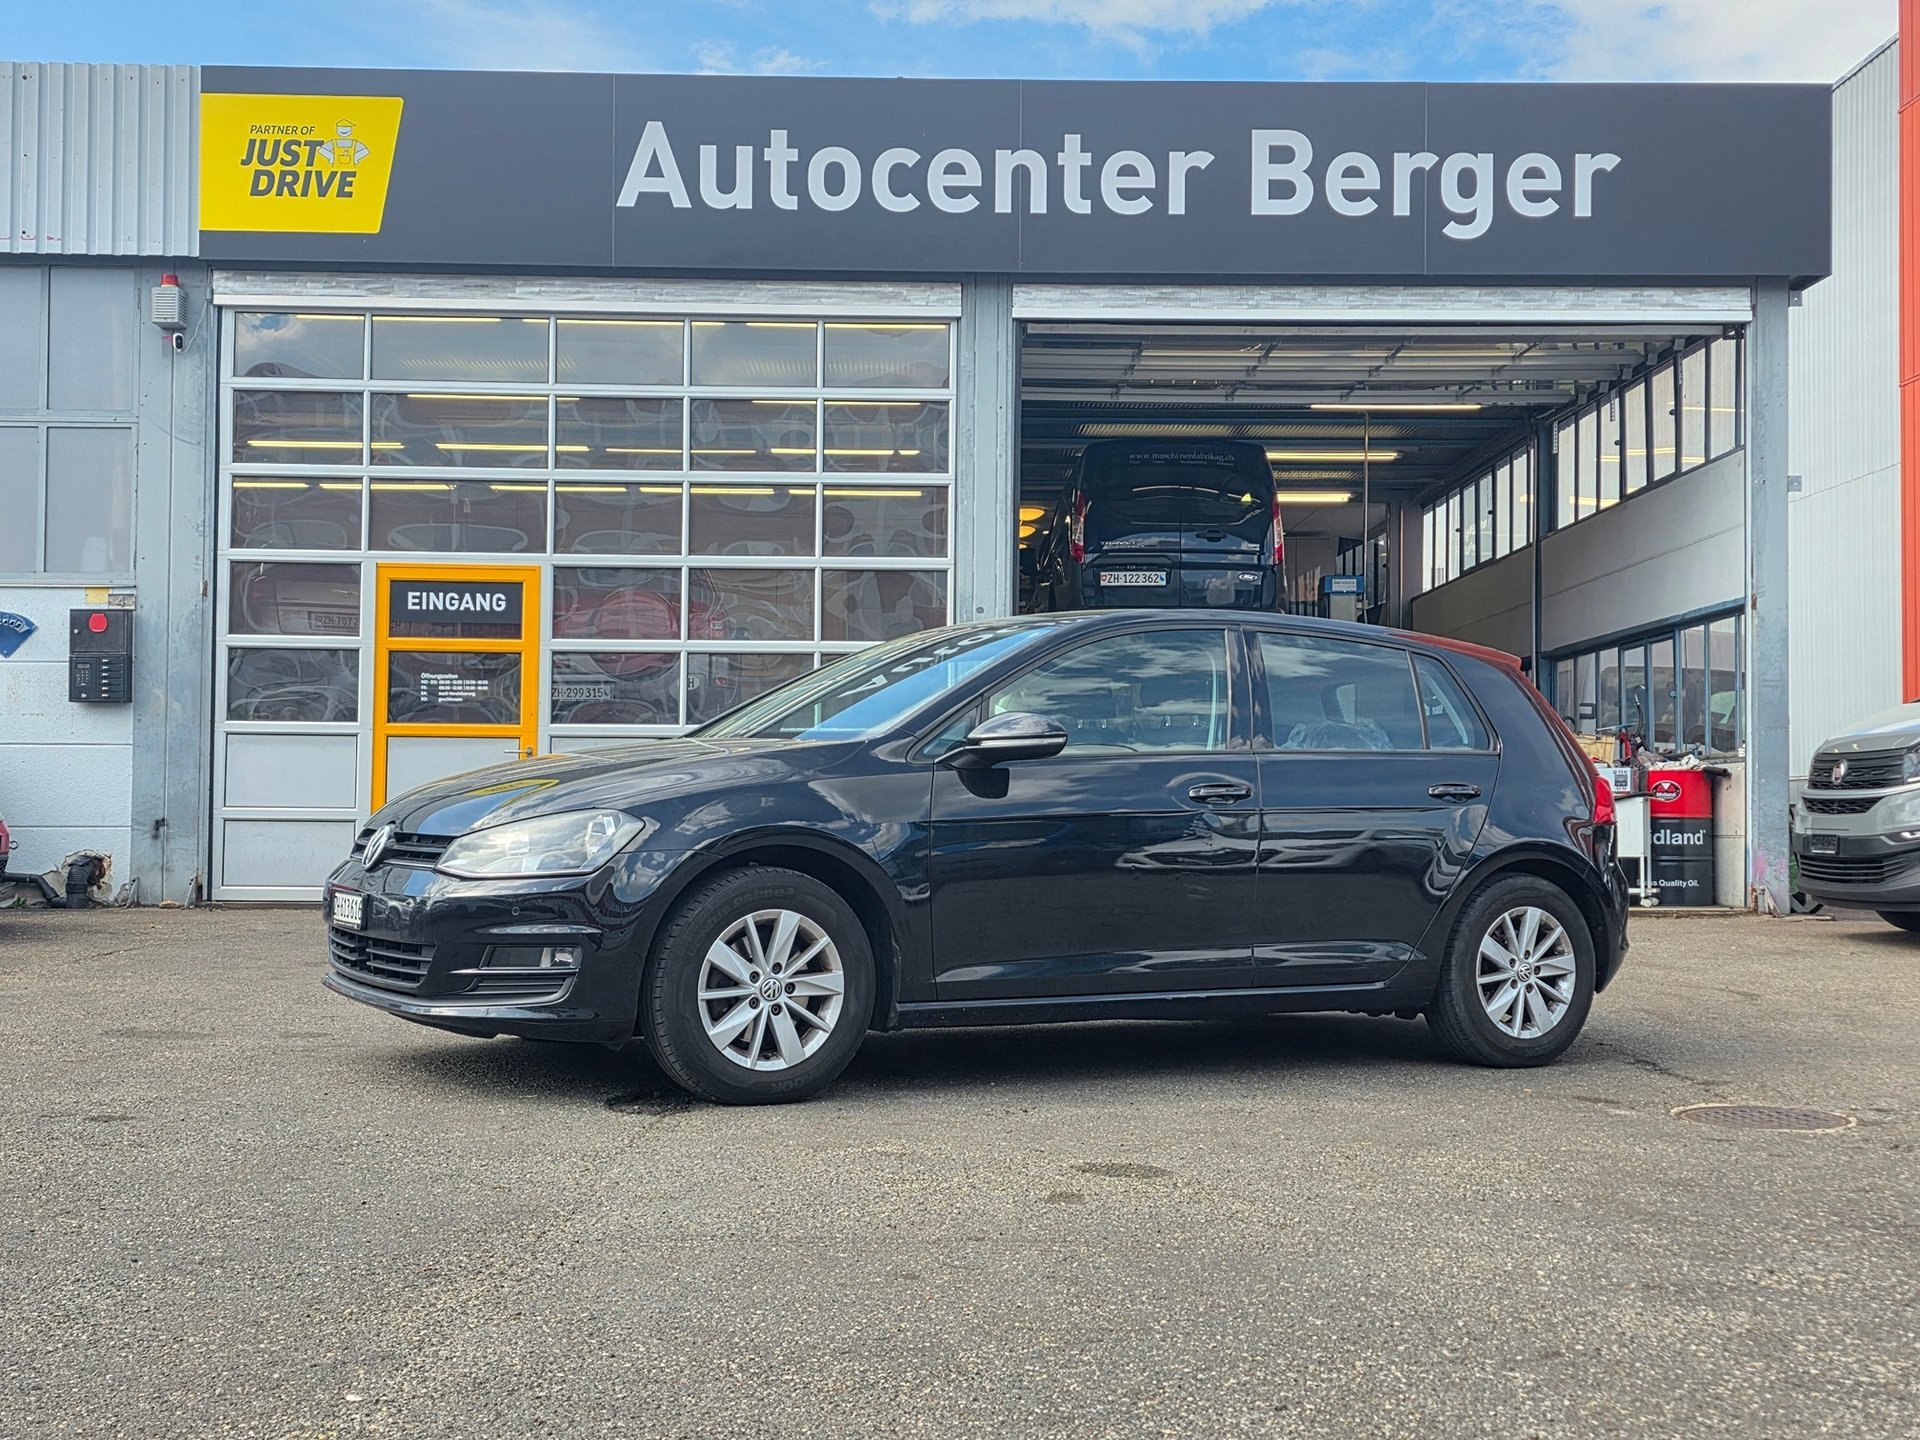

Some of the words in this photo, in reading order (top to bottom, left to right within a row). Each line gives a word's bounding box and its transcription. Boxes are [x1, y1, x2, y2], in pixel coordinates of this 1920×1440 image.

[249, 124, 298, 135] PARTNER
[300, 125, 315, 135] OF
[240, 138, 324, 167] JUST
[249, 169, 357, 198] DRIVE
[616, 121, 1215, 214] Autocenter
[1251, 129, 1622, 239] Berger
[407, 591, 507, 612] EINGANG
[1659, 879, 1687, 888] Quality
